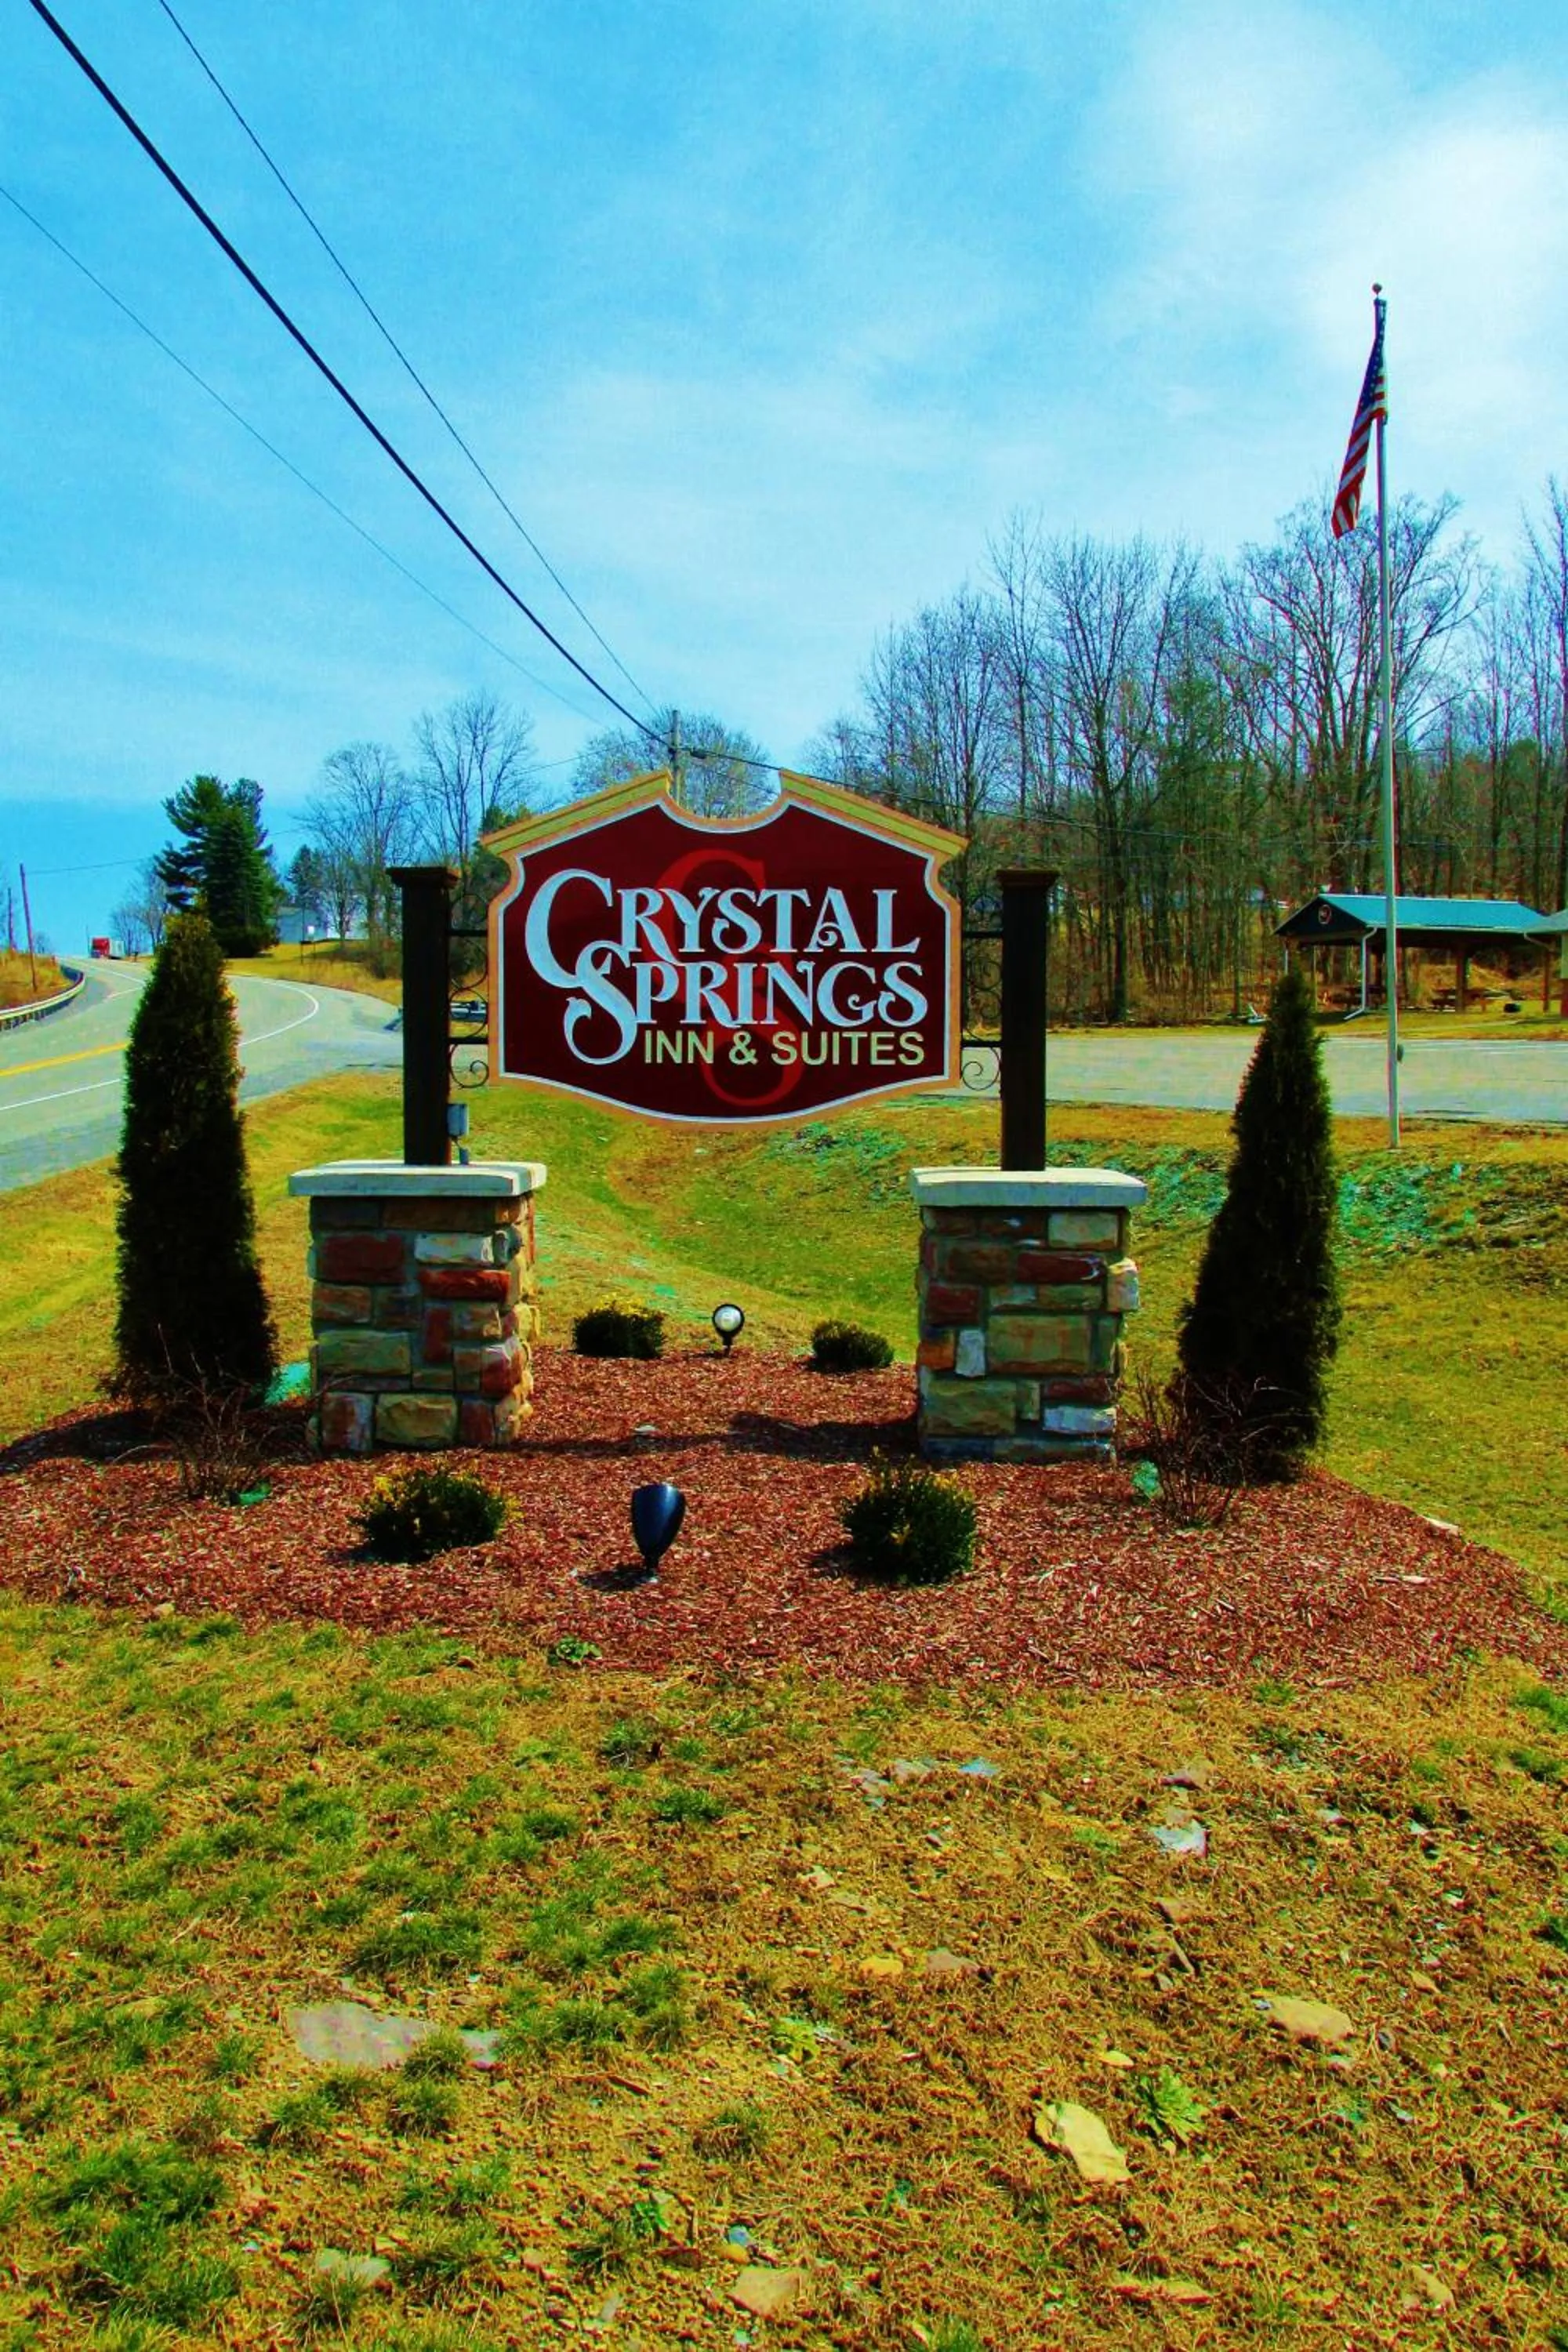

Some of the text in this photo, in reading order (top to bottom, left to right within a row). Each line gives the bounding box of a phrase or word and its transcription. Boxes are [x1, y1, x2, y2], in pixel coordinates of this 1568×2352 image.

[524, 869, 921, 989] CRYSTAL
[563, 939, 929, 1065] SPRINGS
[644, 1030, 925, 1066] INN & SUITES
